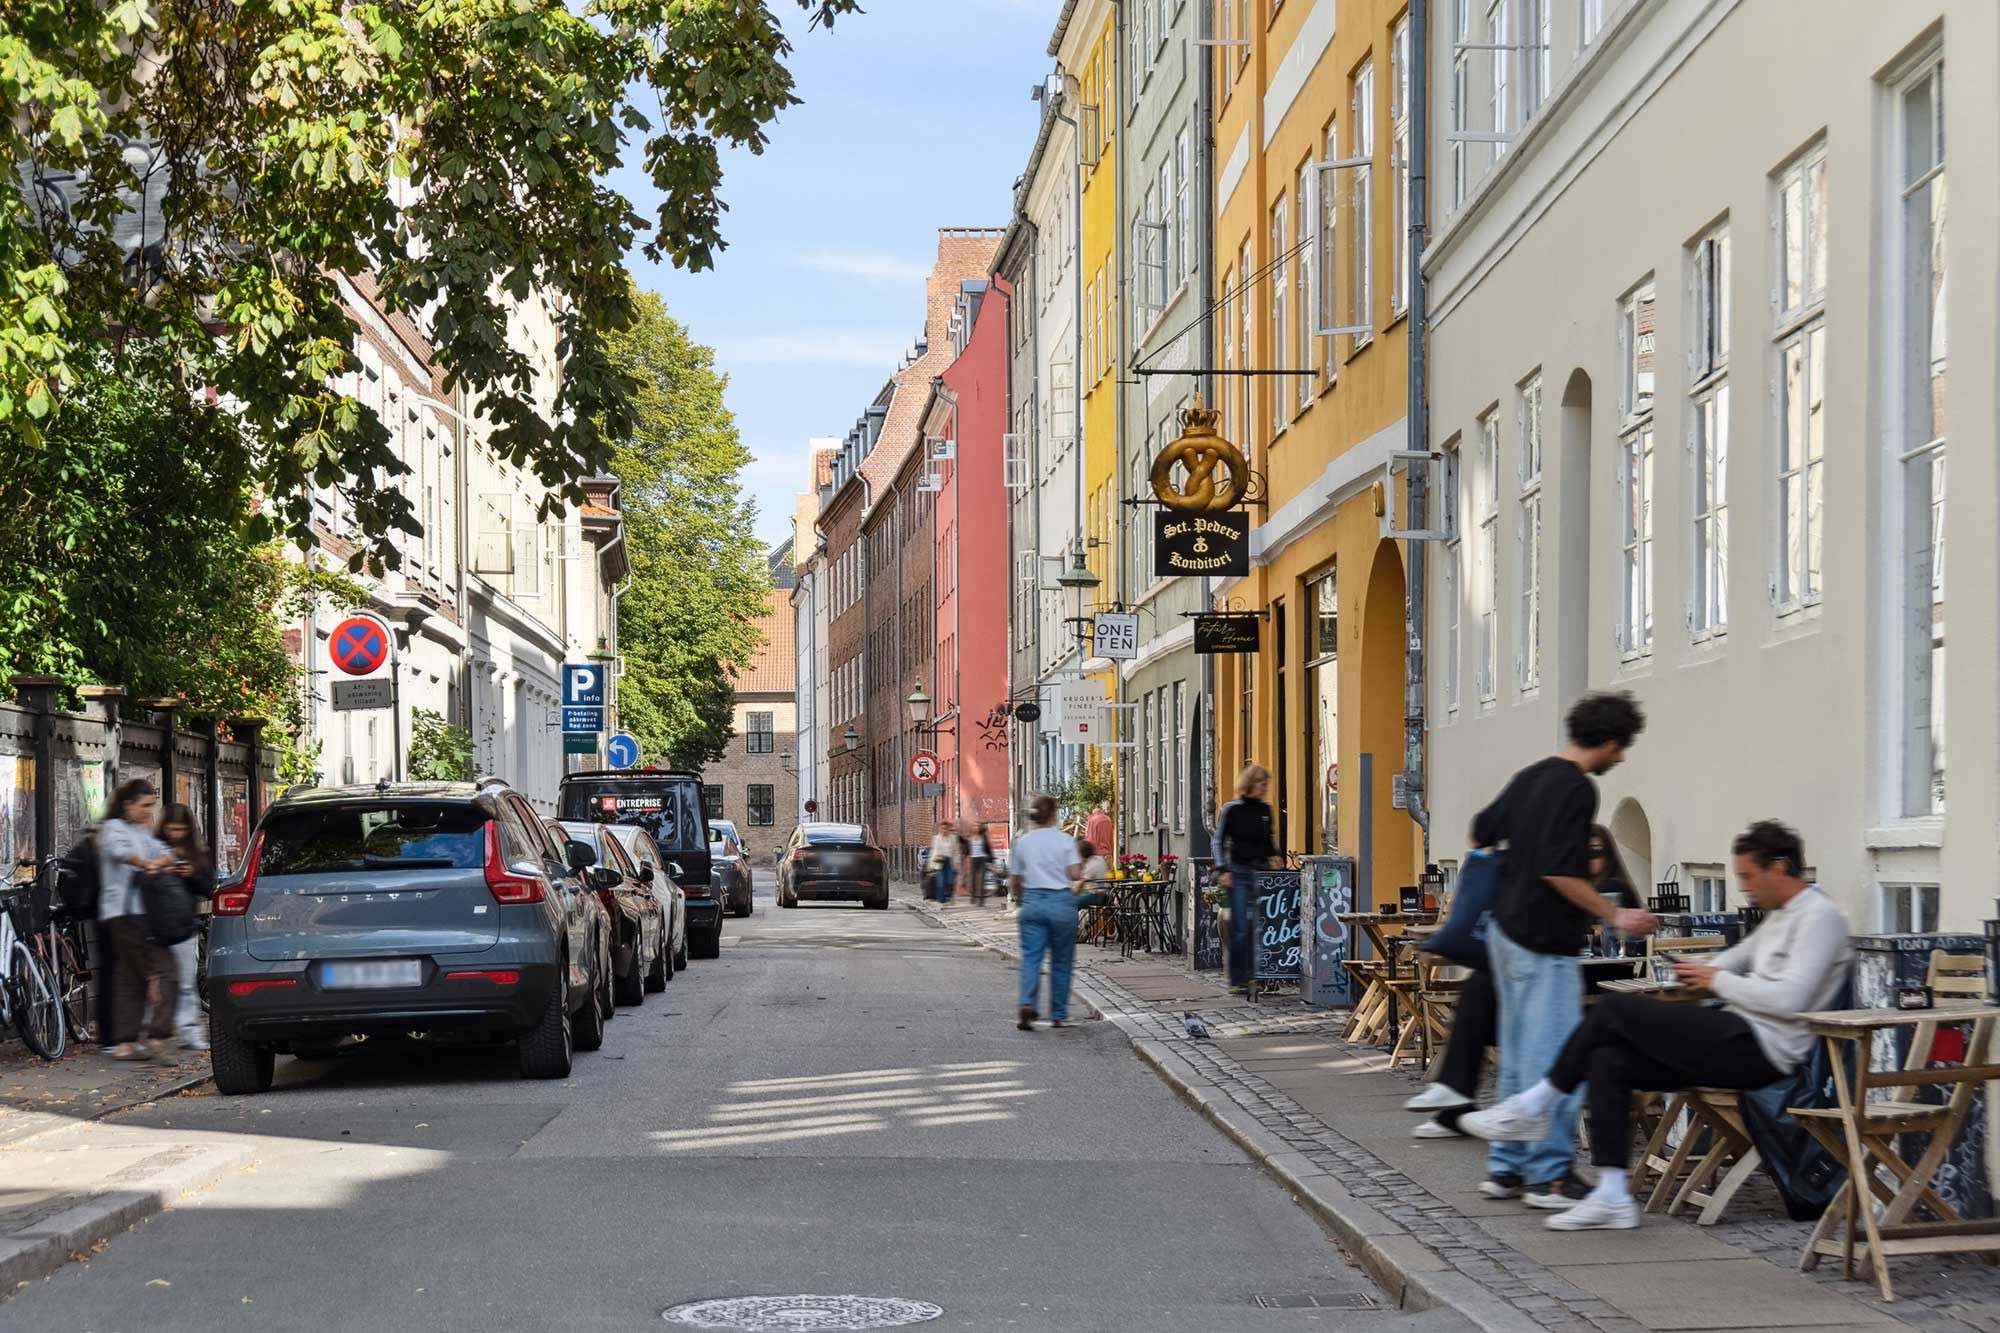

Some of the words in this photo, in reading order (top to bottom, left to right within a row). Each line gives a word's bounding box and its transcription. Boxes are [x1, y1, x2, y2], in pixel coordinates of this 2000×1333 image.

[1163, 521, 1191, 539] Sct.
[1193, 518, 1241, 541] Peders
[1168, 551, 1232, 570] Konditori
[1097, 624, 1133, 637] ONE
[1197, 620, 1236, 638] Future
[1221, 632, 1256, 643] Home
[1096, 637, 1133, 650] TEN
[571, 668, 595, 702] P
[583, 694, 600, 702] info
[603, 800, 613, 808] JC
[616, 798, 662, 808] ENTREPRISE
[1258, 889, 1287, 919] Vi
[1263, 919, 1302, 946] åbe
[1278, 946, 1305, 967] B
